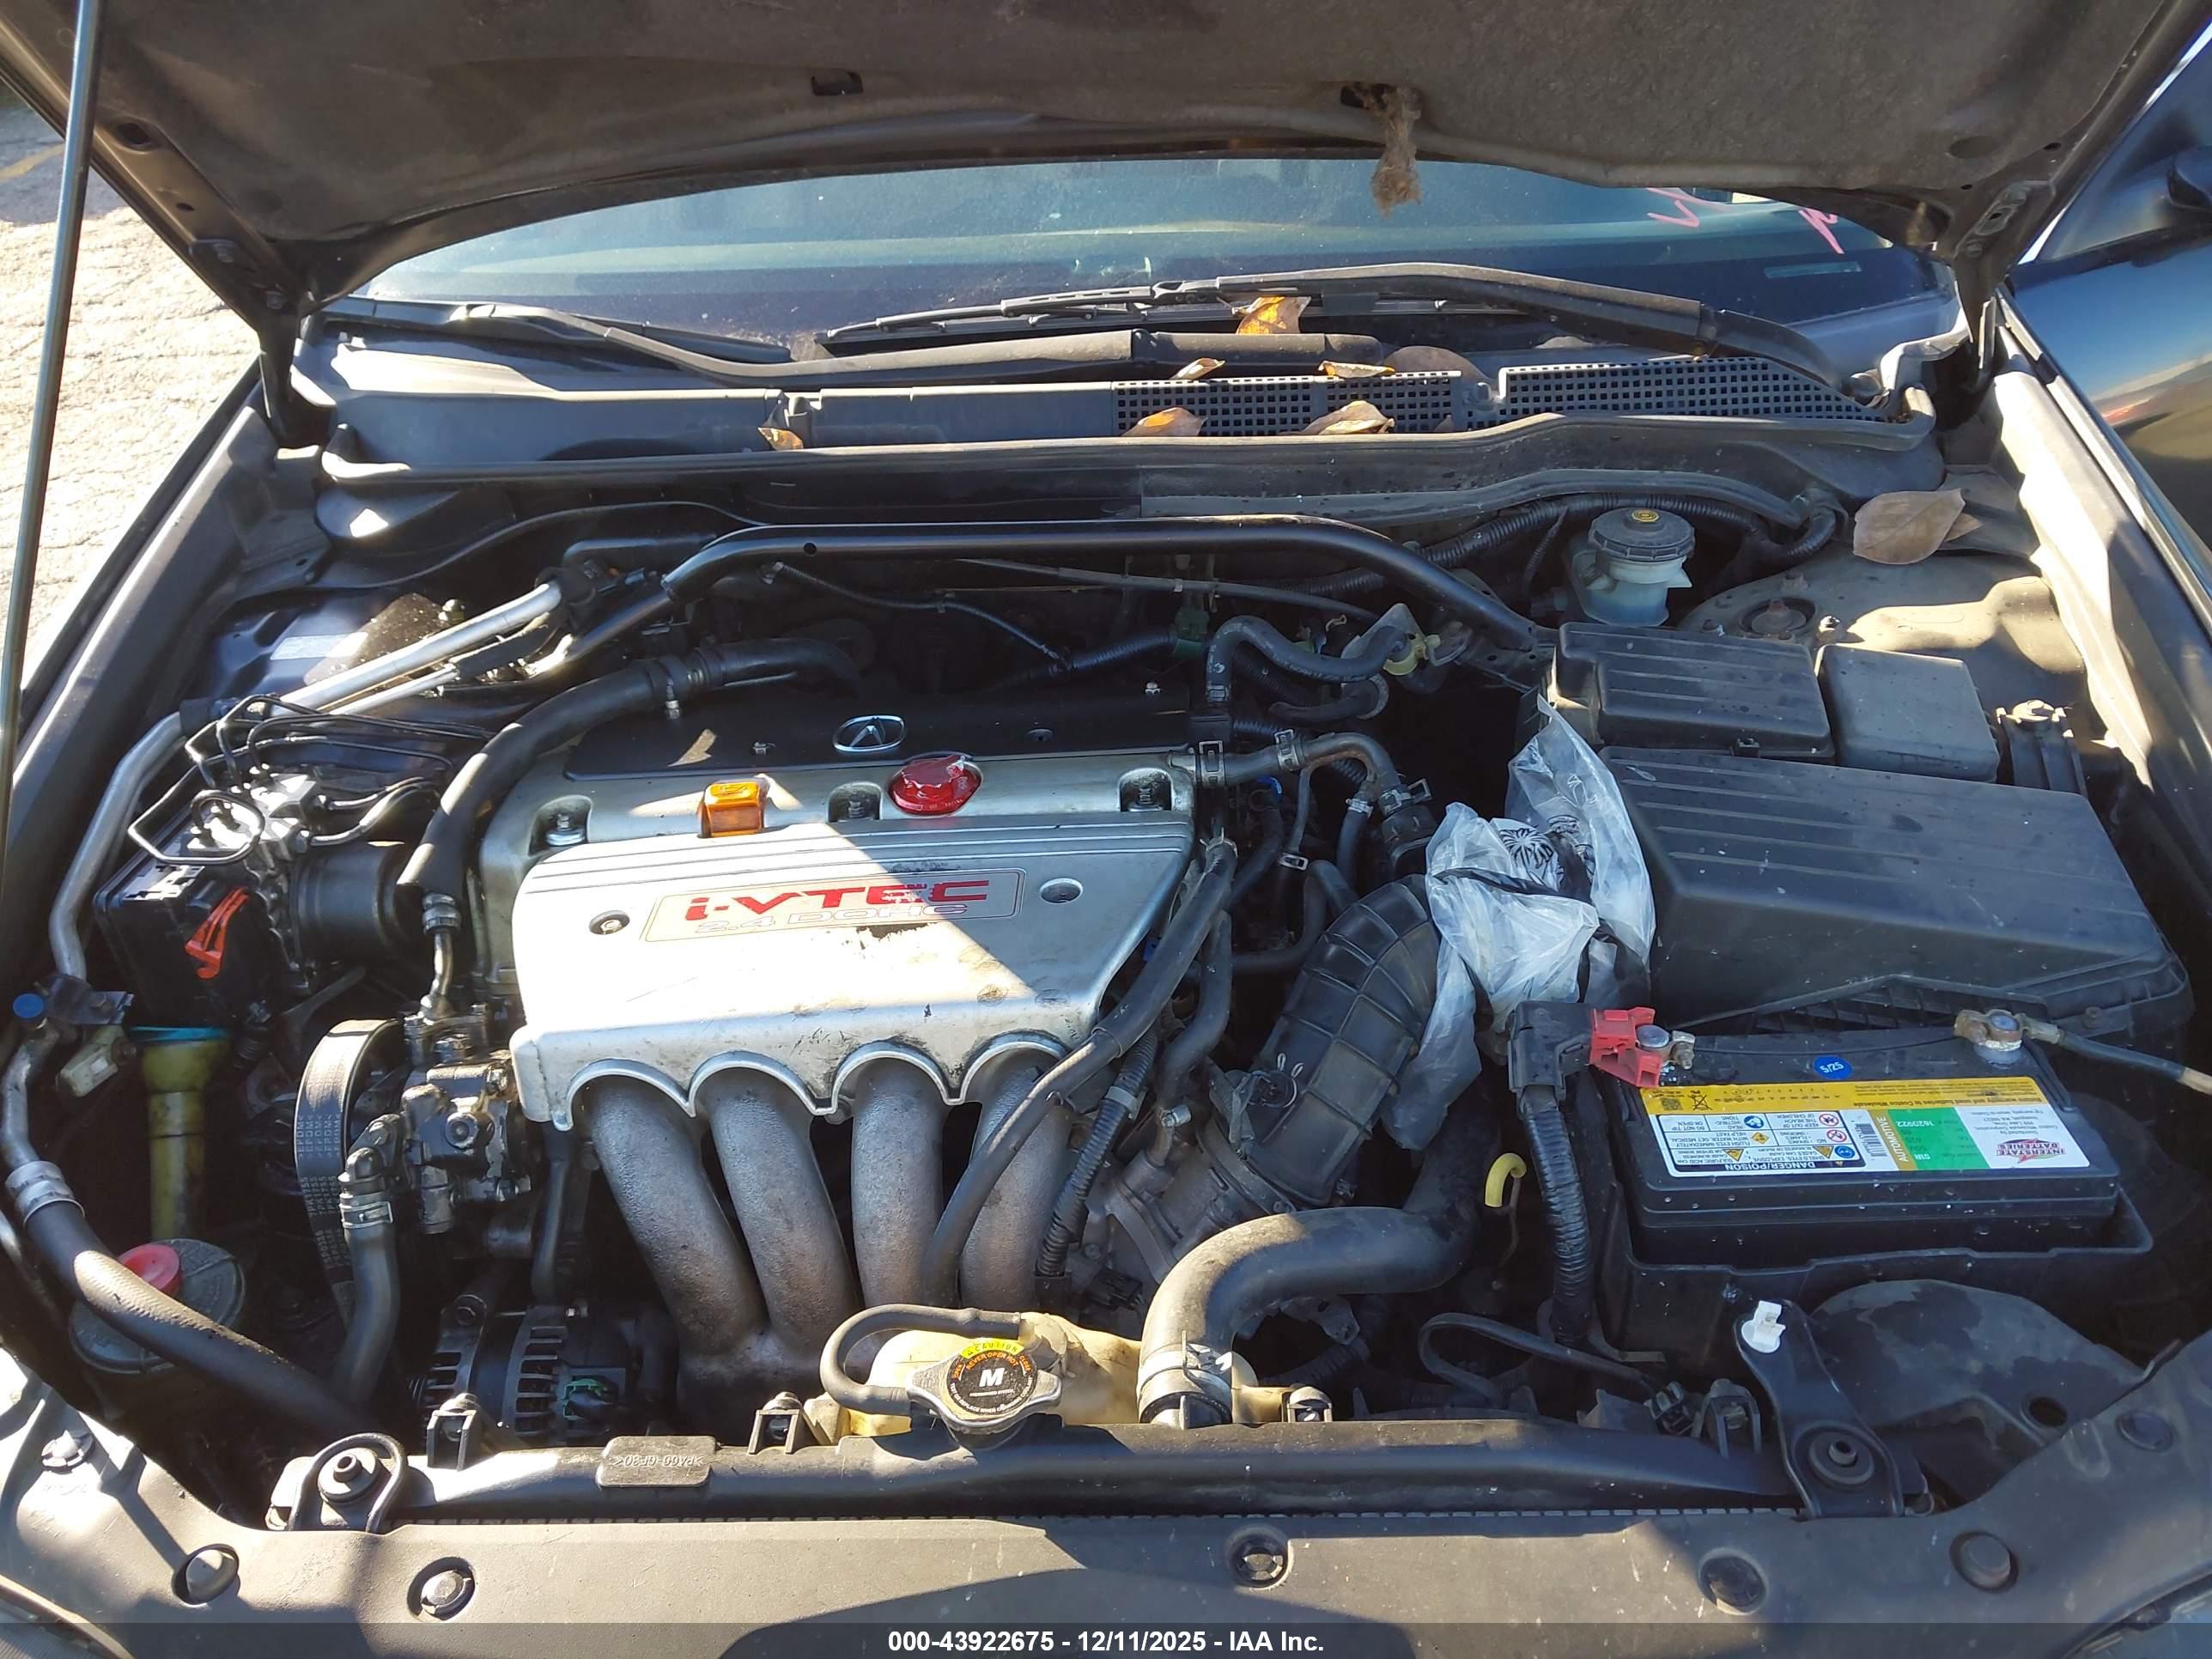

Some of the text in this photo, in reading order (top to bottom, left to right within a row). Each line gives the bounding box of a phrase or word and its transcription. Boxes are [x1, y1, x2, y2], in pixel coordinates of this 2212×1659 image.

[695, 903, 968, 934] 2.4 DOHC
[1820, 1061, 1844, 1073] 5/25
[1876, 1115, 1909, 1163] AUTOMOTIVE
[1724, 1161, 1816, 1170] DANGER/POISON
[975, 1342, 1018, 1352] CAUTION
[966, 1353, 988, 1370] NEVER
[1006, 1354, 1019, 1367] HOT
